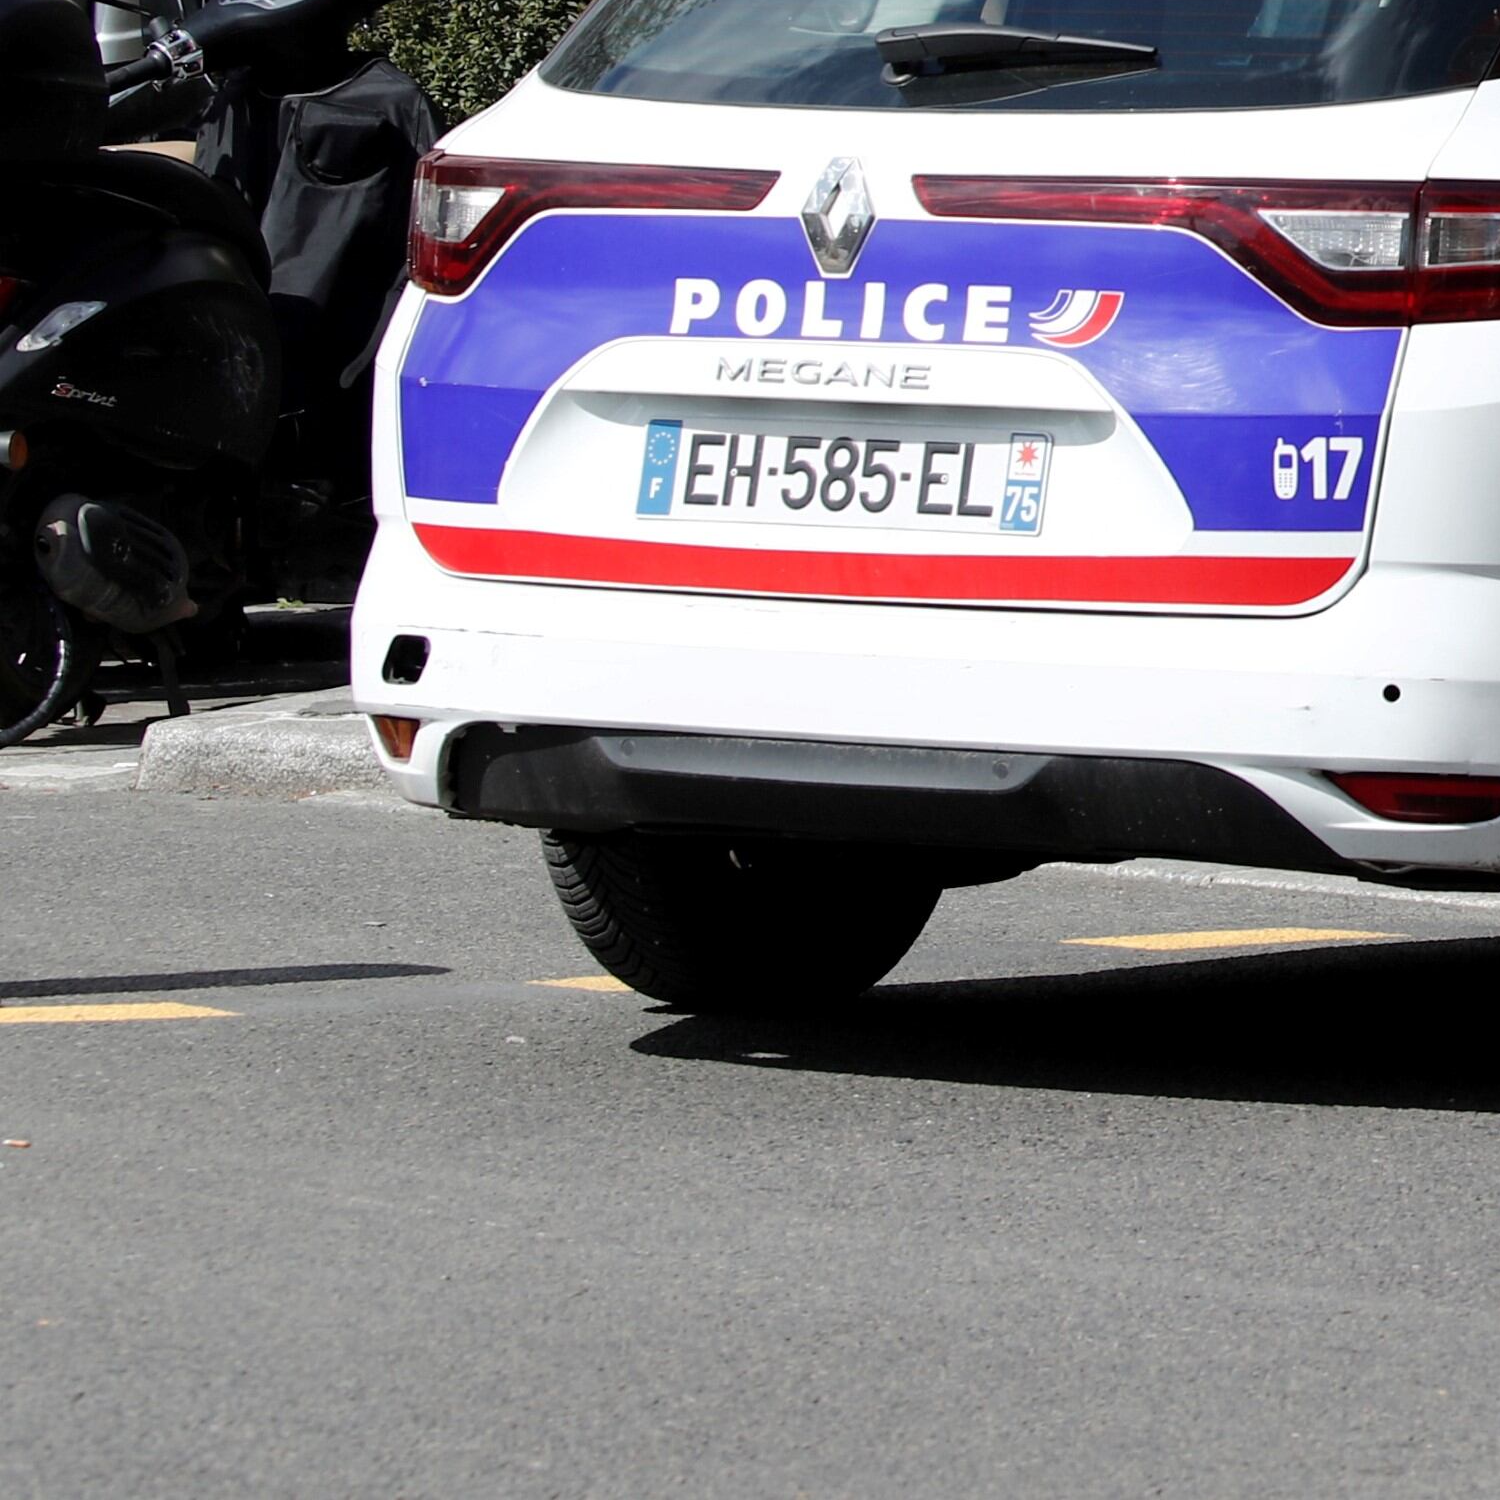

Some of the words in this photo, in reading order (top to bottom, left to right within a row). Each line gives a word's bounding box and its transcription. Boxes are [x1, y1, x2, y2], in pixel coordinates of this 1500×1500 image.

[669, 277, 1012, 343] POLICE
[716, 356, 931, 390] MEGANE
[649, 476, 663, 499] F
[683, 433, 994, 518] EH-585-EL
[1300, 436, 1364, 500] 17
[1005, 485, 1039, 522] 75
